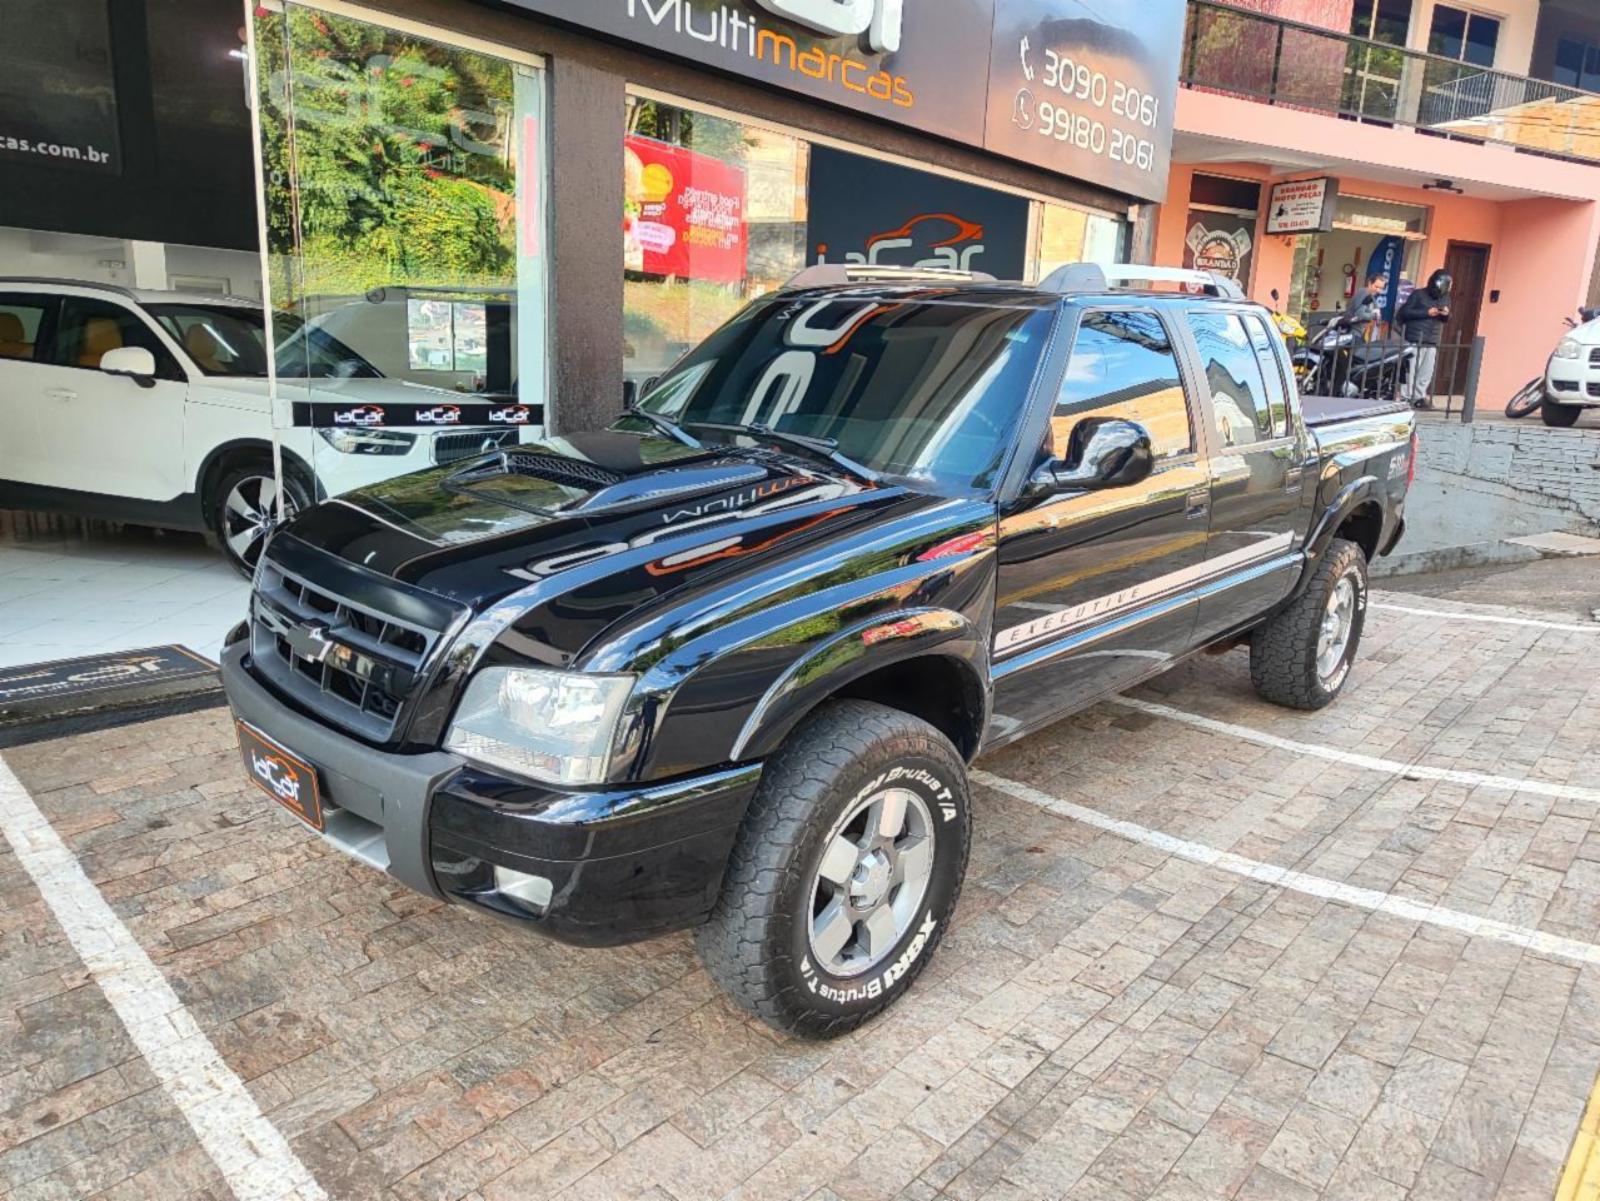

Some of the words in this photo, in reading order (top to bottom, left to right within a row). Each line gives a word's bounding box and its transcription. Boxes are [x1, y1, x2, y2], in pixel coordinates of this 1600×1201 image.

[1043, 48, 1107, 107] 3090
[1112, 80, 1159, 128] 2061
[1039, 102, 1106, 154] 99180
[1109, 129, 1154, 171] 2061
[1009, 587, 1141, 642] EXECUTIVE
[884, 765, 942, 792] Brutus
[936, 786, 958, 823] T/A
[799, 954, 819, 994] T/A
[818, 977, 883, 1005] Brutus
